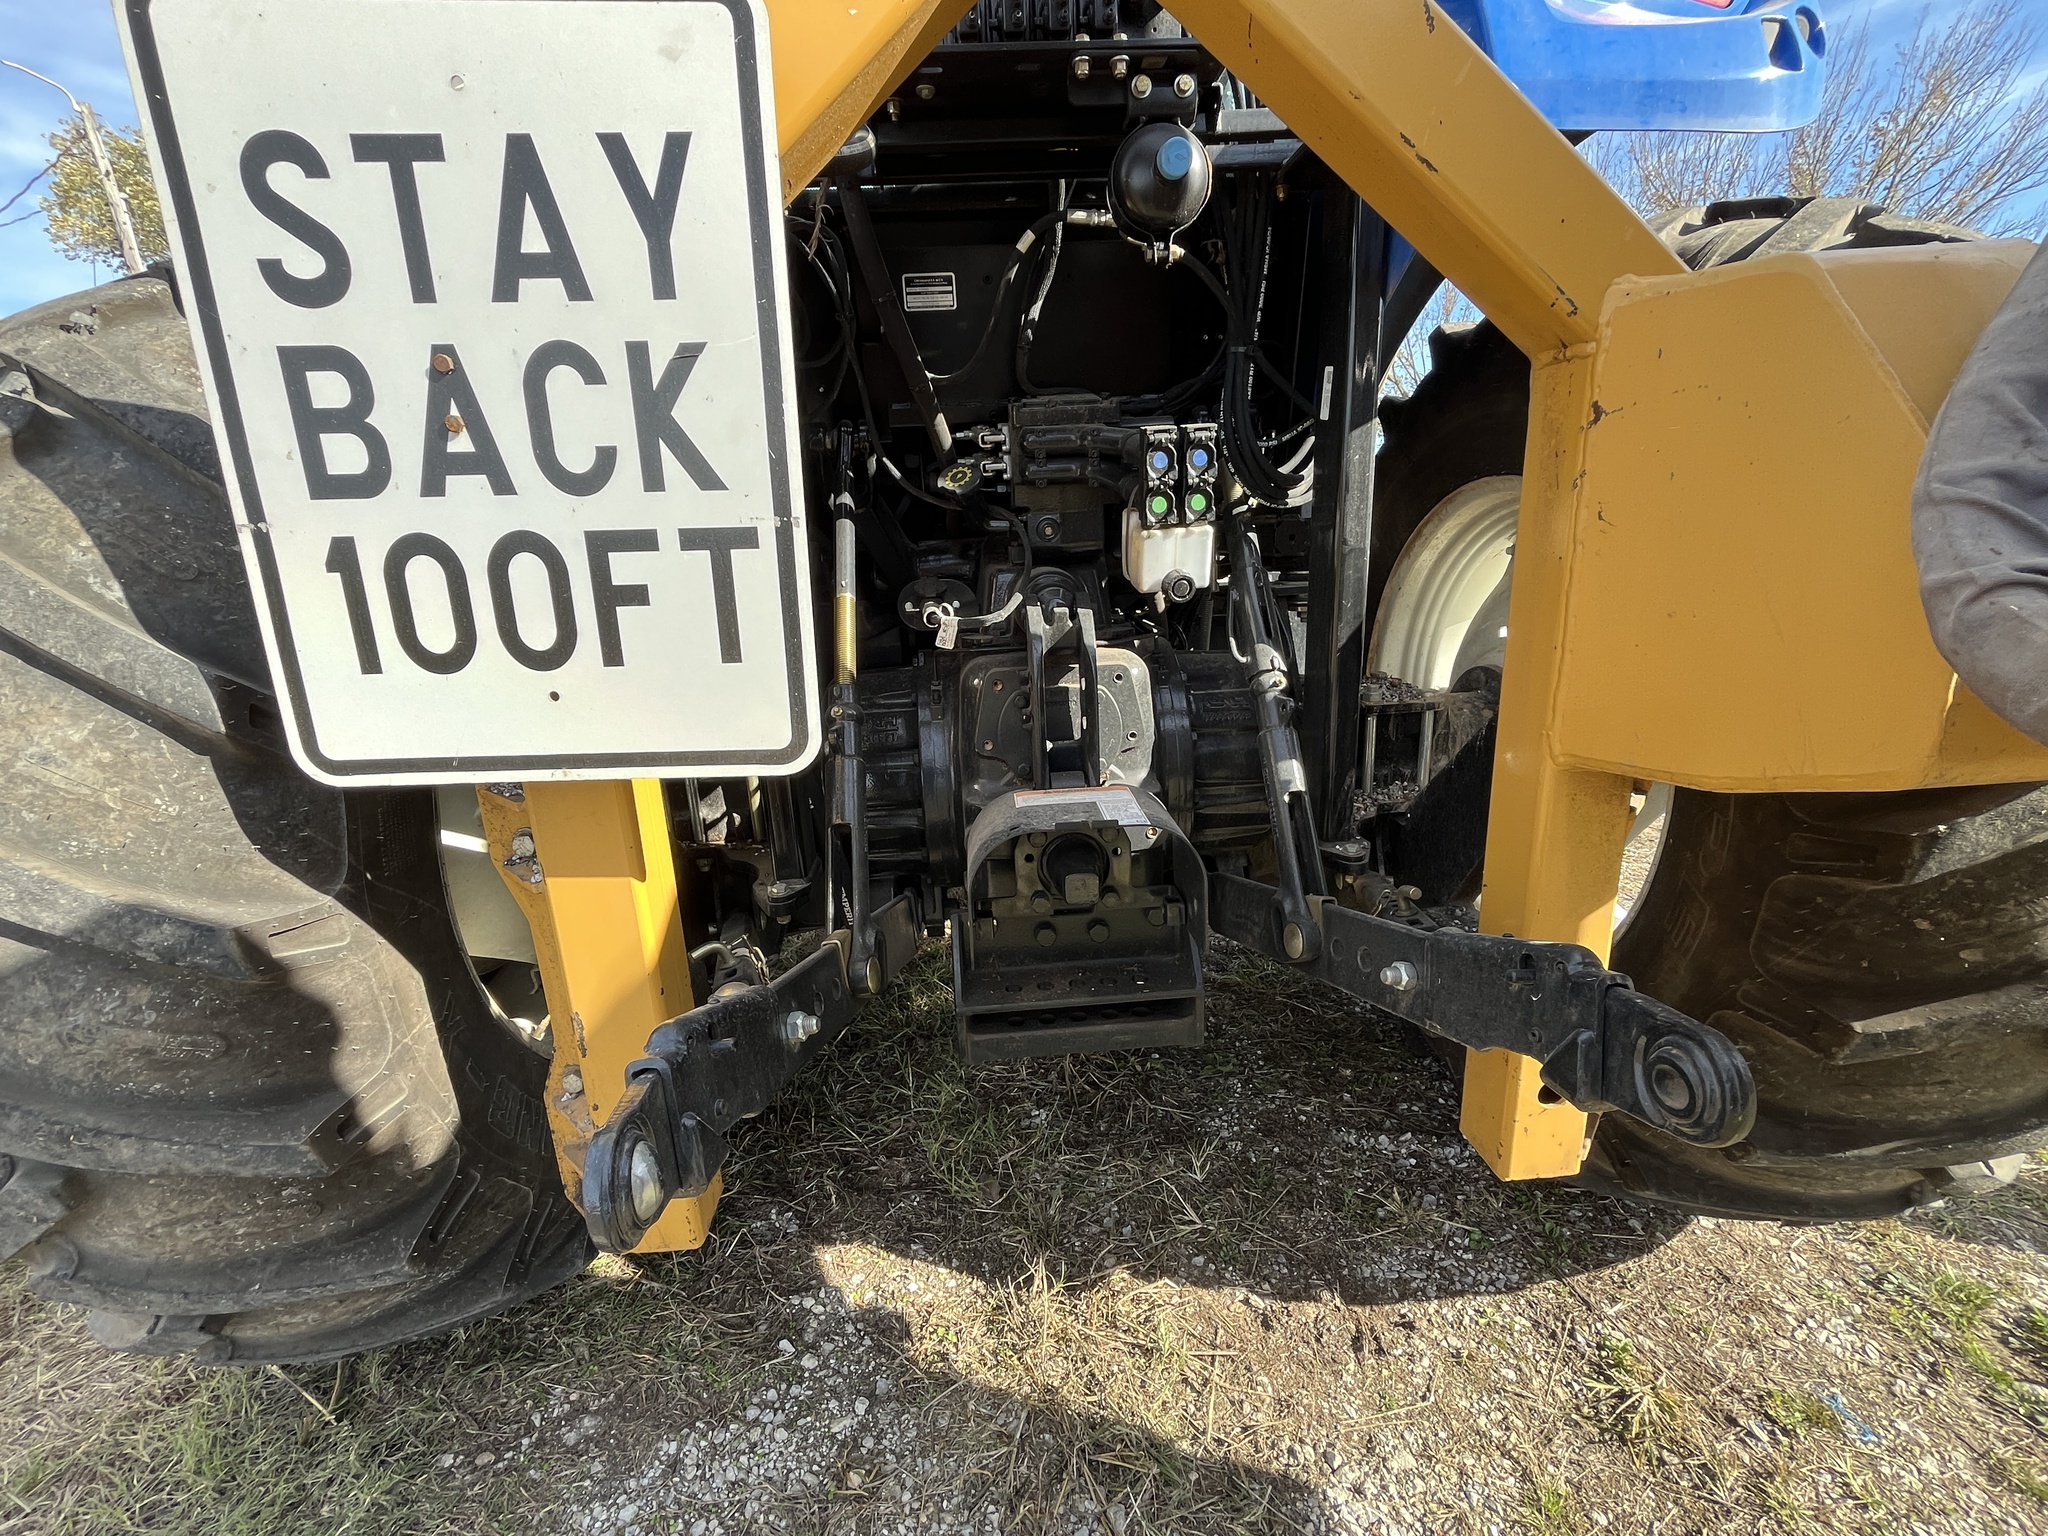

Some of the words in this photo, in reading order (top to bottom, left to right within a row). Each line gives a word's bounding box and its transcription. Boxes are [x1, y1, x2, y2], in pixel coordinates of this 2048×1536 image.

[239, 129, 692, 309] STAY
[276, 339, 730, 501] BACK
[324, 526, 760, 675] 100FT
